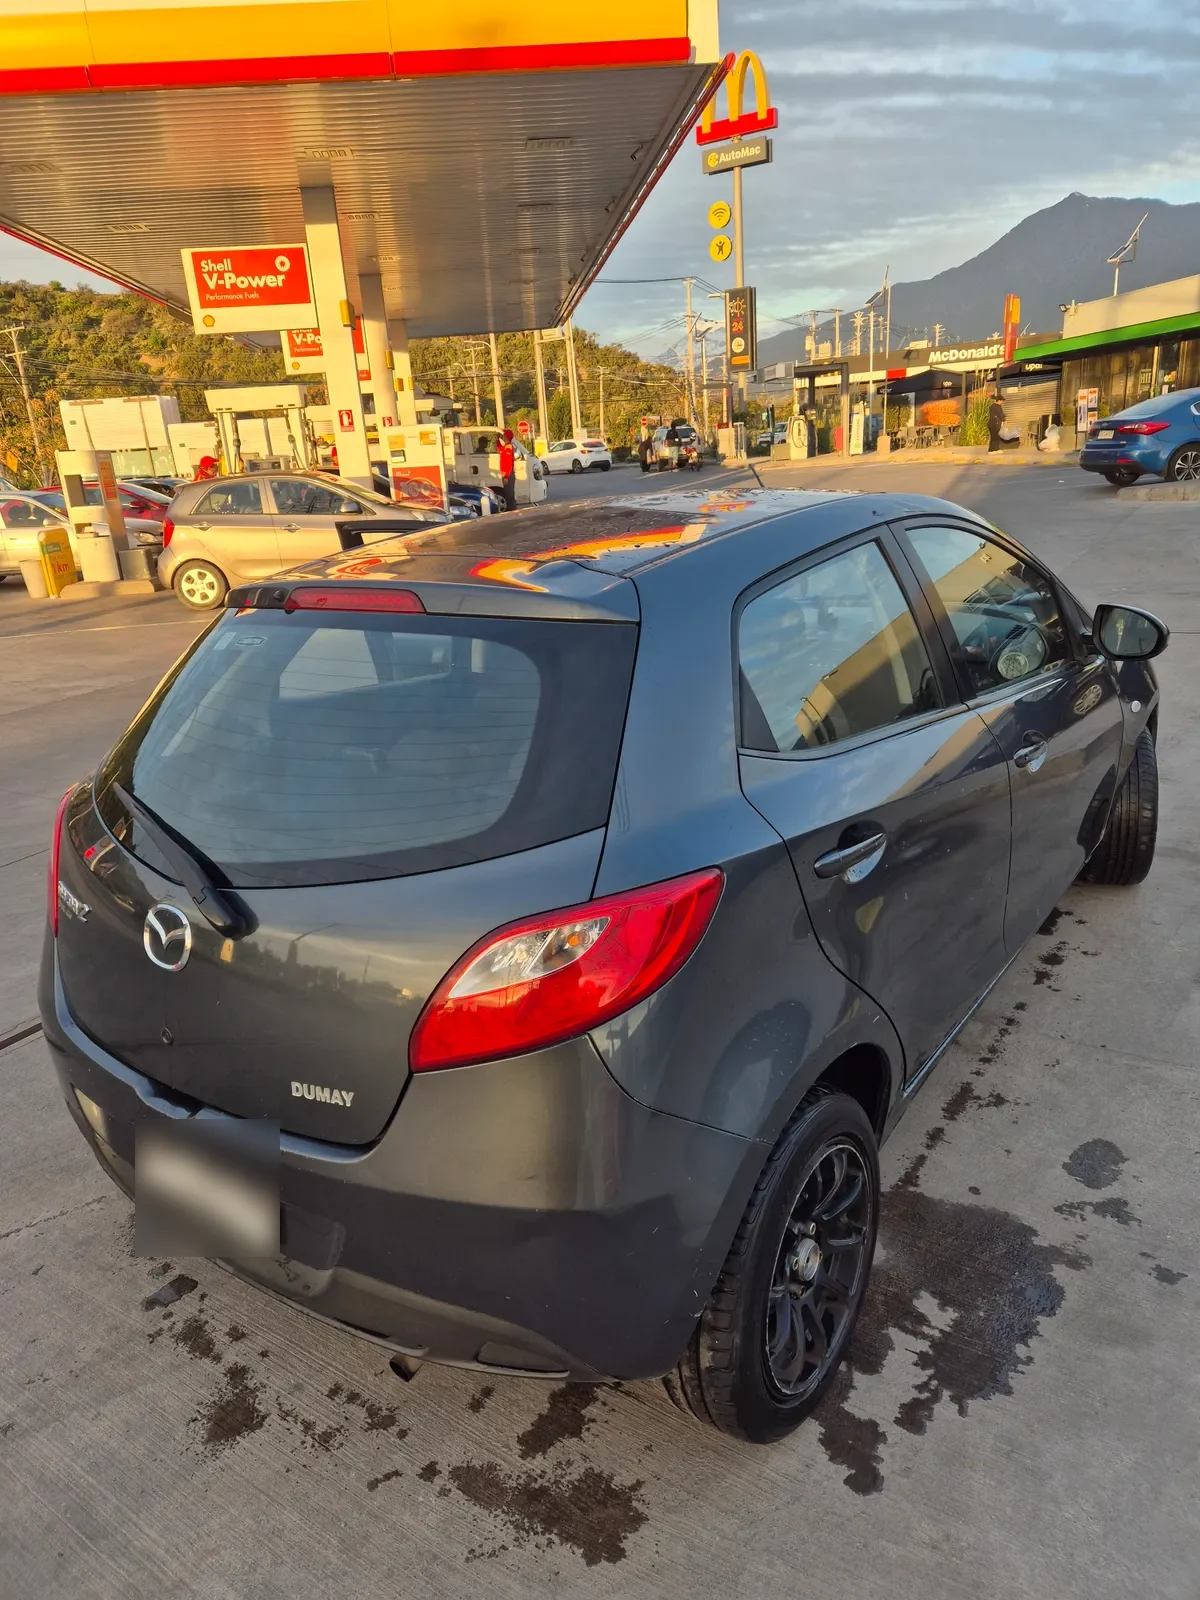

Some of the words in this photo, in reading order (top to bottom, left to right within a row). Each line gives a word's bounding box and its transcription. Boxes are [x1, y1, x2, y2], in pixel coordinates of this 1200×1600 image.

[719, 145, 761, 163] AutoMac
[201, 259, 231, 272] Shell
[203, 273, 285, 290] V-Power
[205, 293, 244, 301] Performance
[244, 291, 260, 299] Fuels
[928, 344, 1005, 363] McDonald's
[291, 1081, 355, 1107] DUMAY
